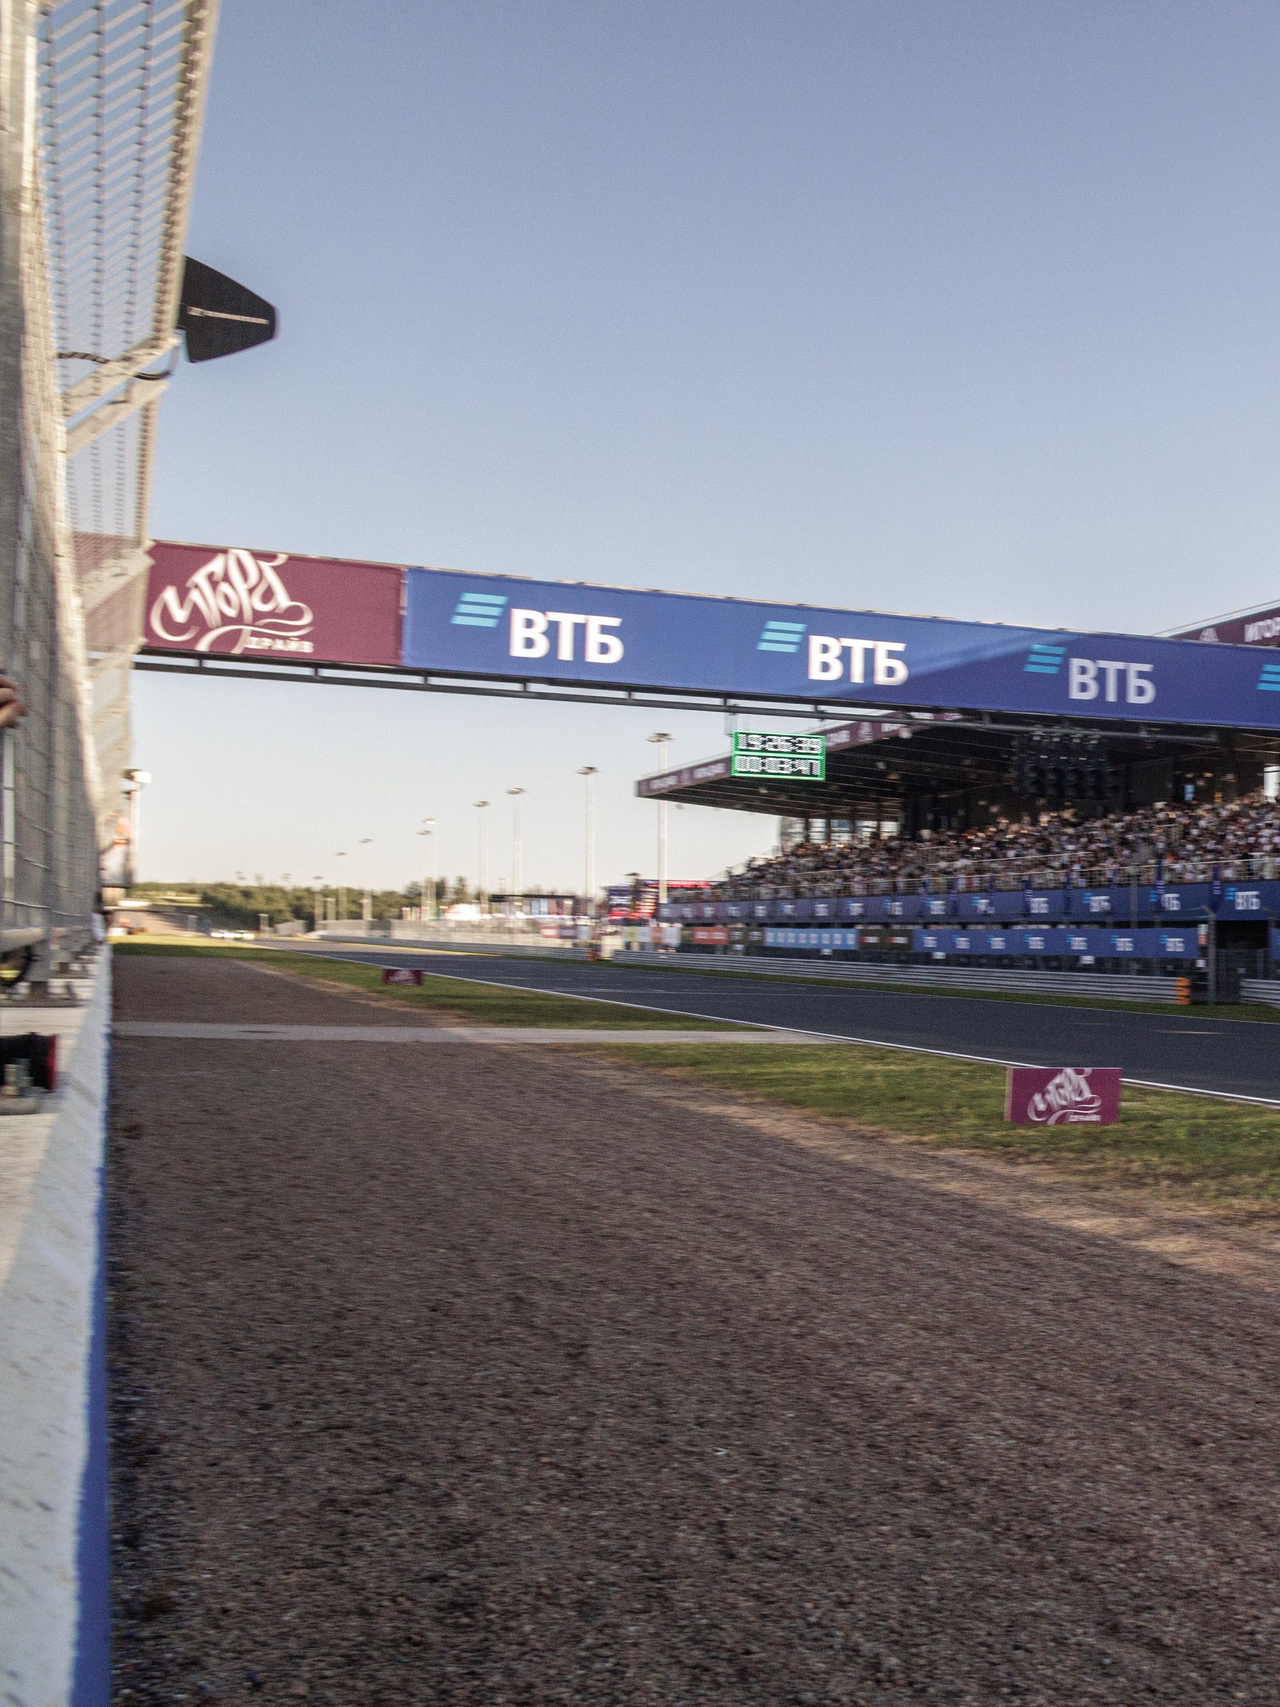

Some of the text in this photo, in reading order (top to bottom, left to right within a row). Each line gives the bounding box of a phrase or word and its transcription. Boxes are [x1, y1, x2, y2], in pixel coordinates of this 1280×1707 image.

[510, 609, 623, 663] ВТБ
[809, 635, 907, 685] ВТБ
[1070, 658, 1155, 703] ВТБ
